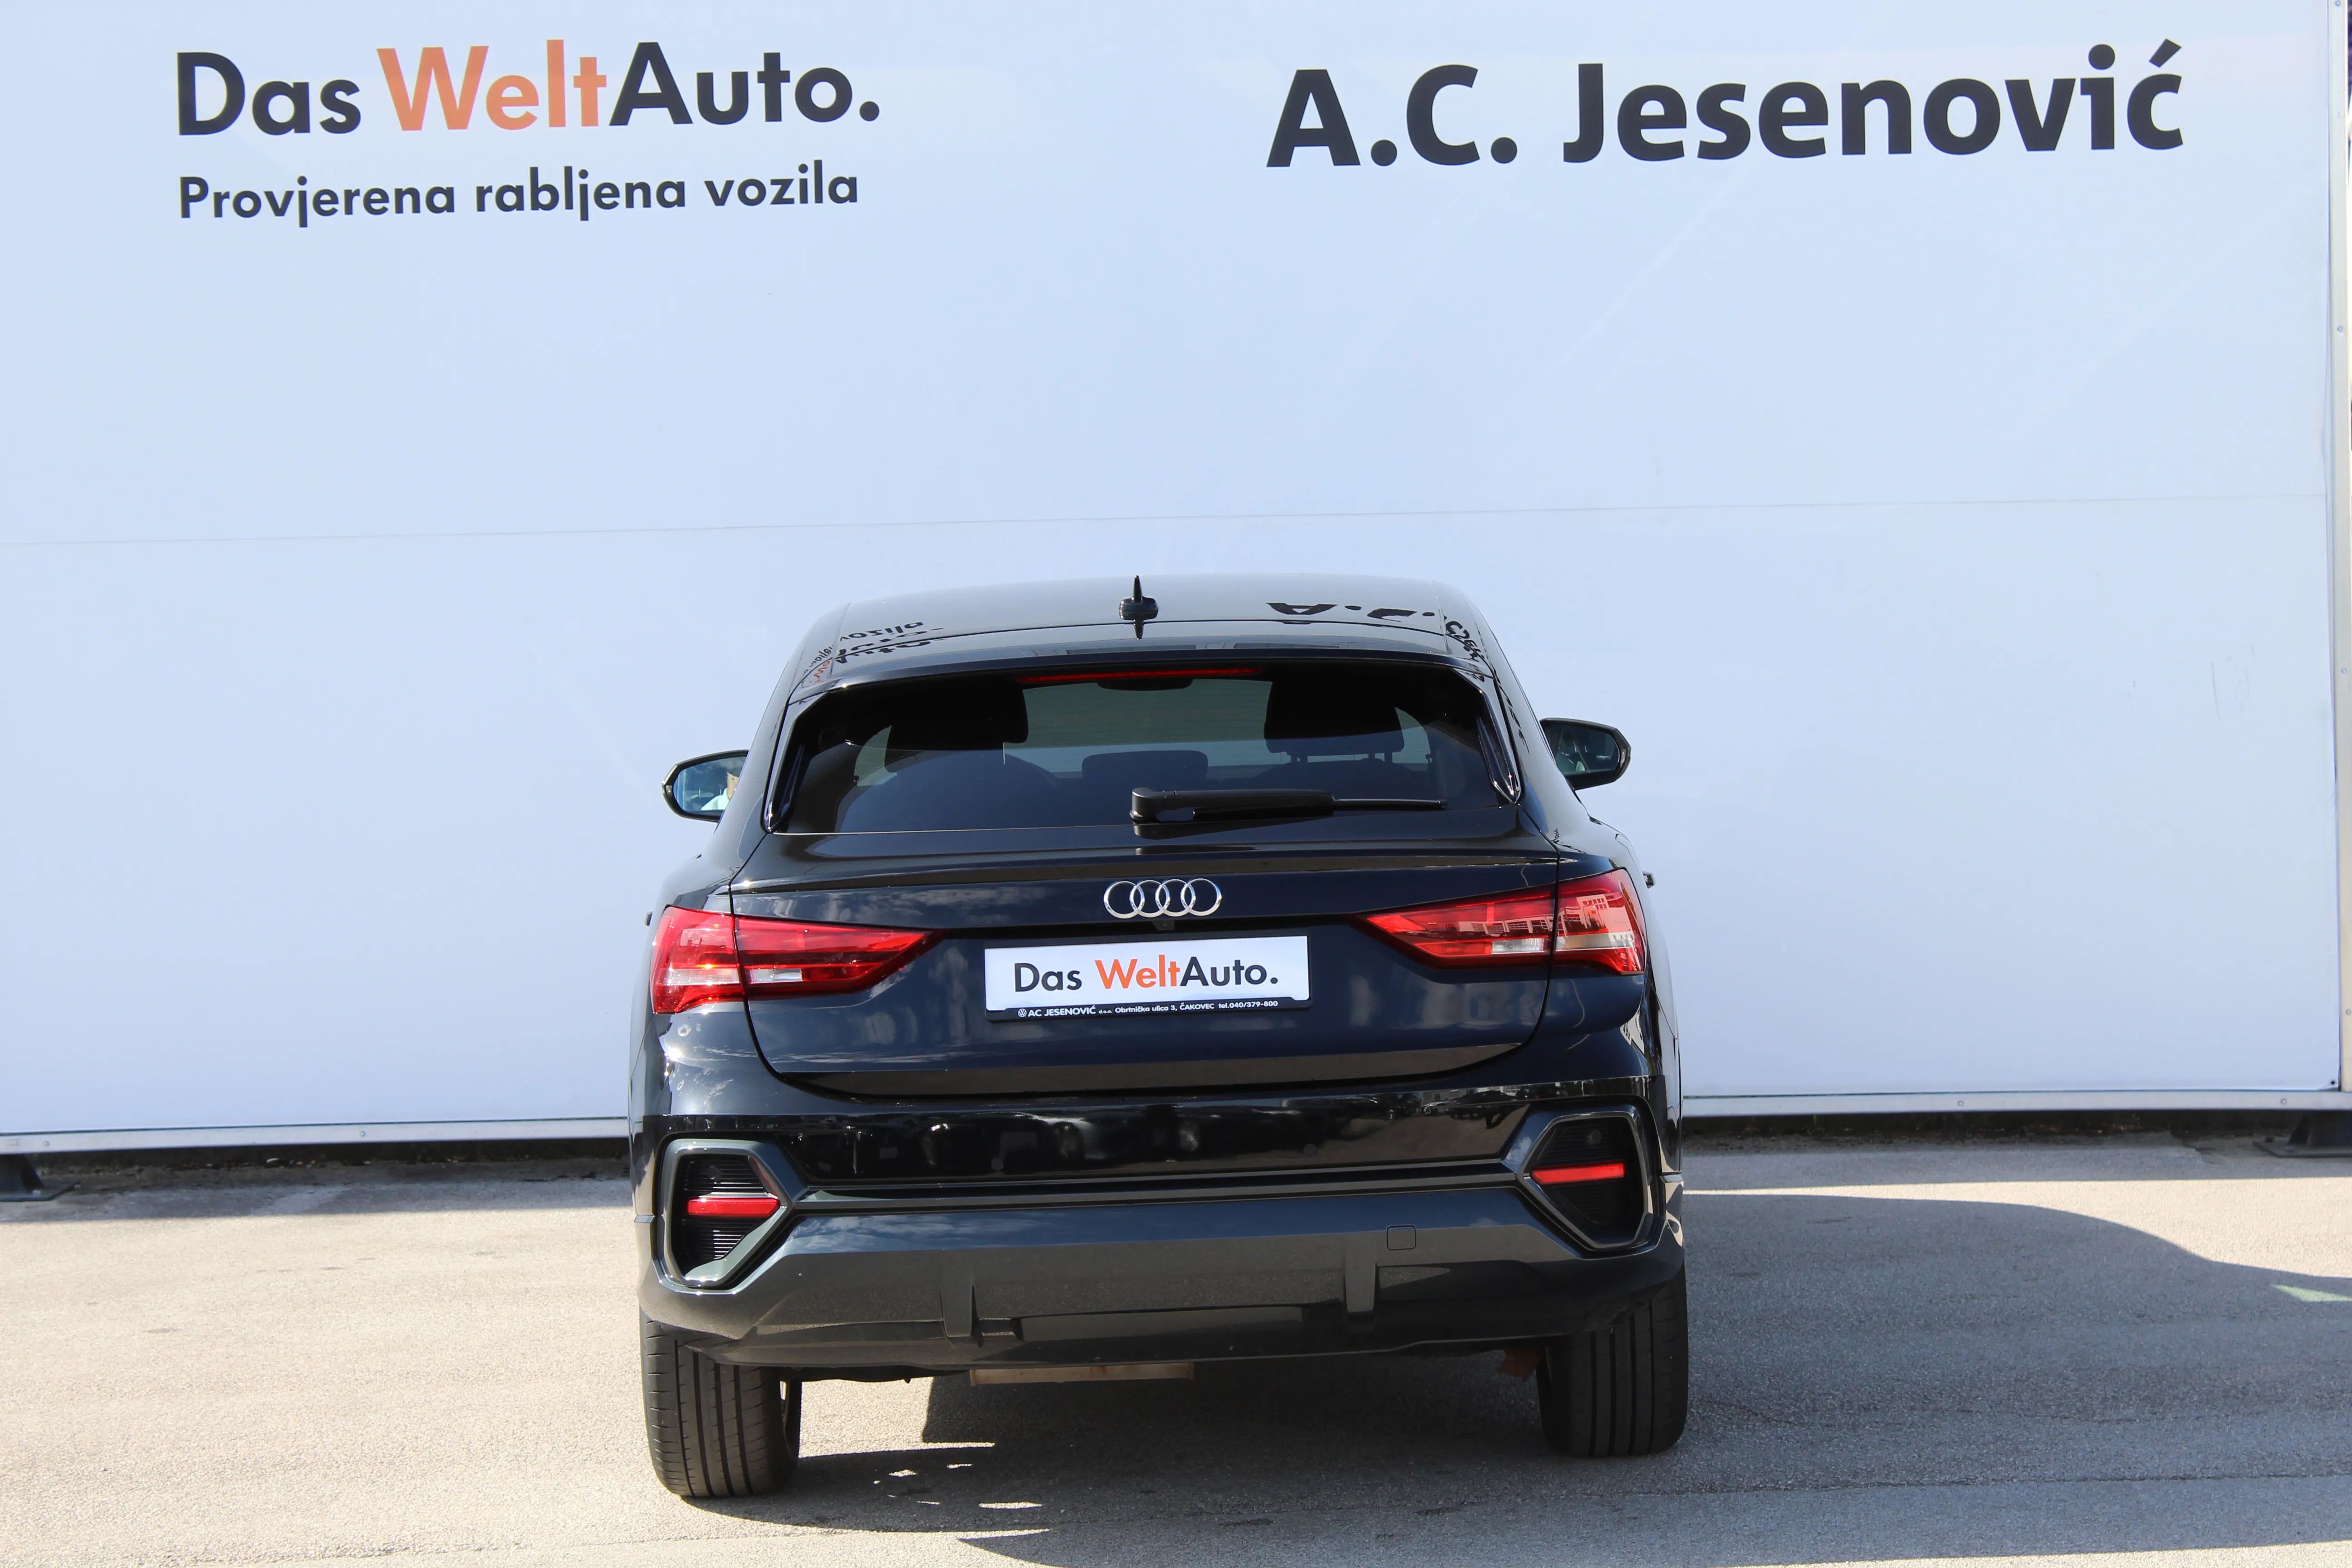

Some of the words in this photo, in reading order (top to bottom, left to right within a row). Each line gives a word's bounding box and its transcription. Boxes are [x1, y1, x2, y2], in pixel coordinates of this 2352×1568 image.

[176, 51, 362, 136] Das
[377, 39, 880, 131] WeltAuto.
[1266, 64, 1518, 168] A.C.
[1563, 38, 2184, 164] Jesenović
[180, 176, 455, 229] Provjerena
[475, 166, 686, 222] rabljena
[703, 159, 858, 207] vozila
[1014, 962, 1083, 993] Das
[1094, 954, 1279, 990] WeltAuto.
[1028, 1009, 1042, 1017] AC
[1044, 1005, 1096, 1017] JESENOVIĆ
[1179, 1002, 1215, 1011] ČAKOVEC
